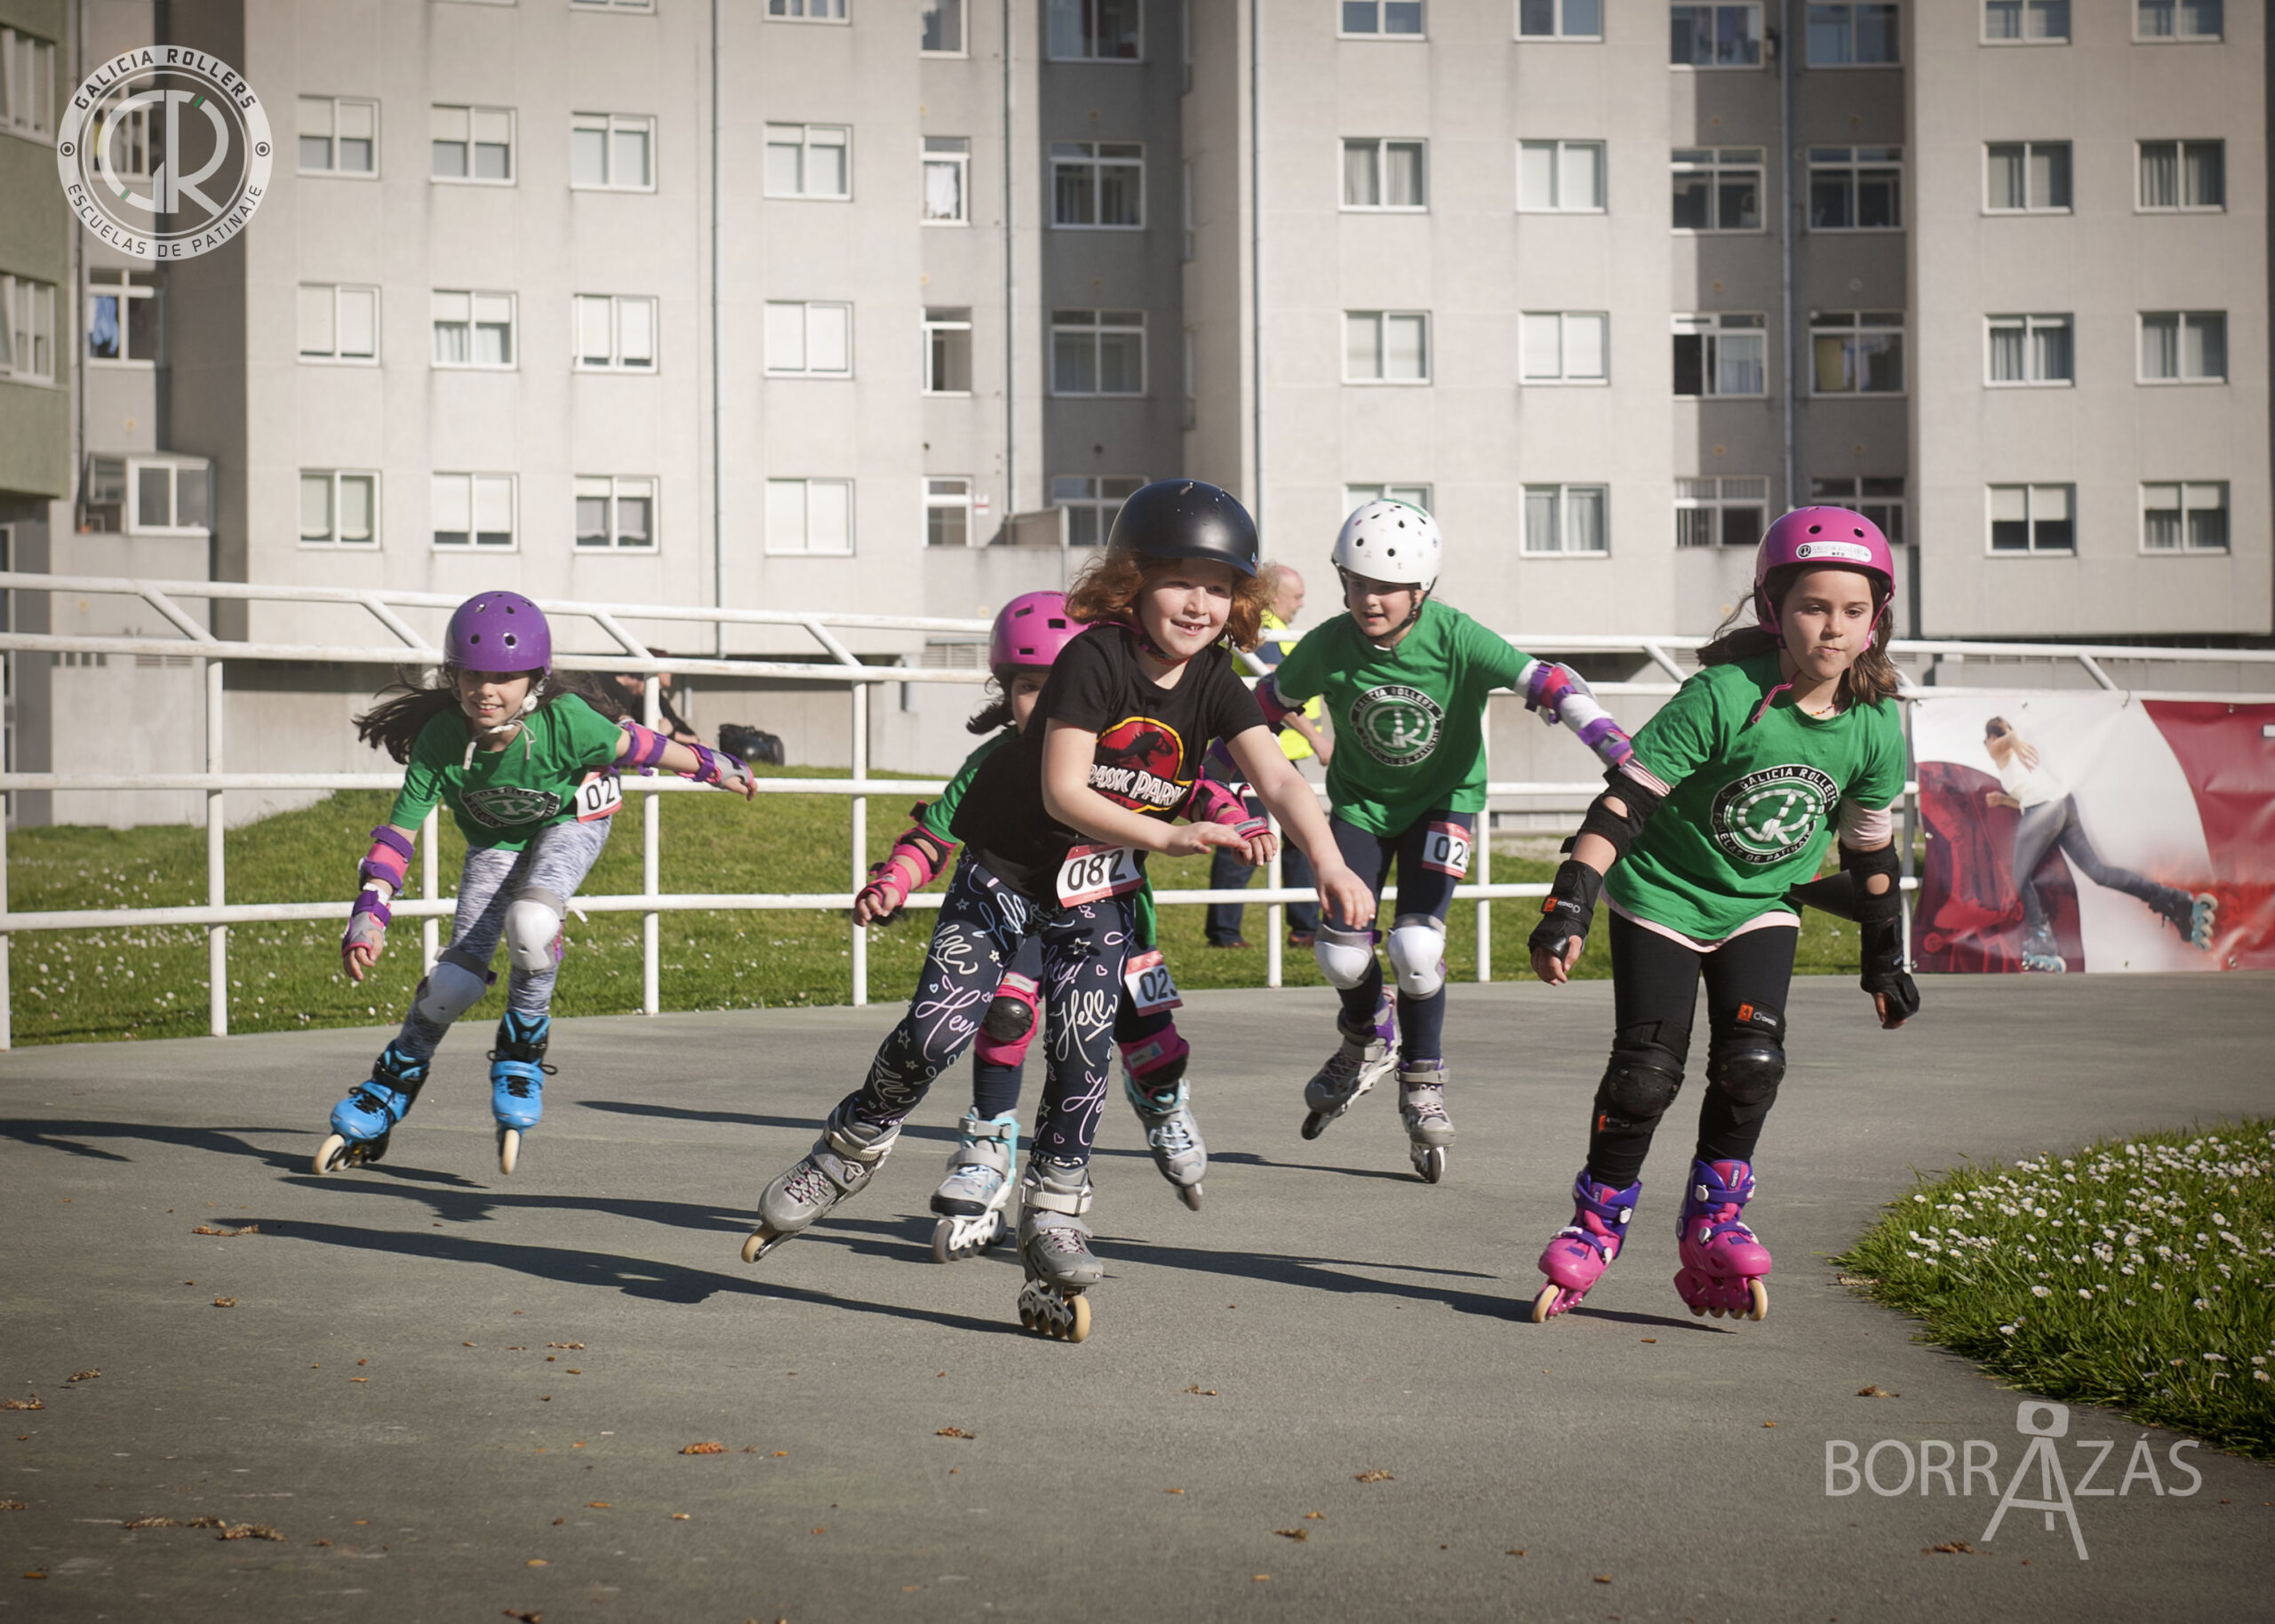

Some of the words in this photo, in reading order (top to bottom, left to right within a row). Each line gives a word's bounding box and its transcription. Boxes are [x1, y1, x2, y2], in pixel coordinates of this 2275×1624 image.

[1128, 769, 1188, 807] PARK
[1739, 767, 1793, 790] GALICIA
[1067, 849, 1127, 891] 082
[1433, 835, 1469, 867] 02
[1139, 967, 1177, 1003] 02
[914, 974, 981, 1063] Hey
[1049, 989, 1118, 1068] Hello
